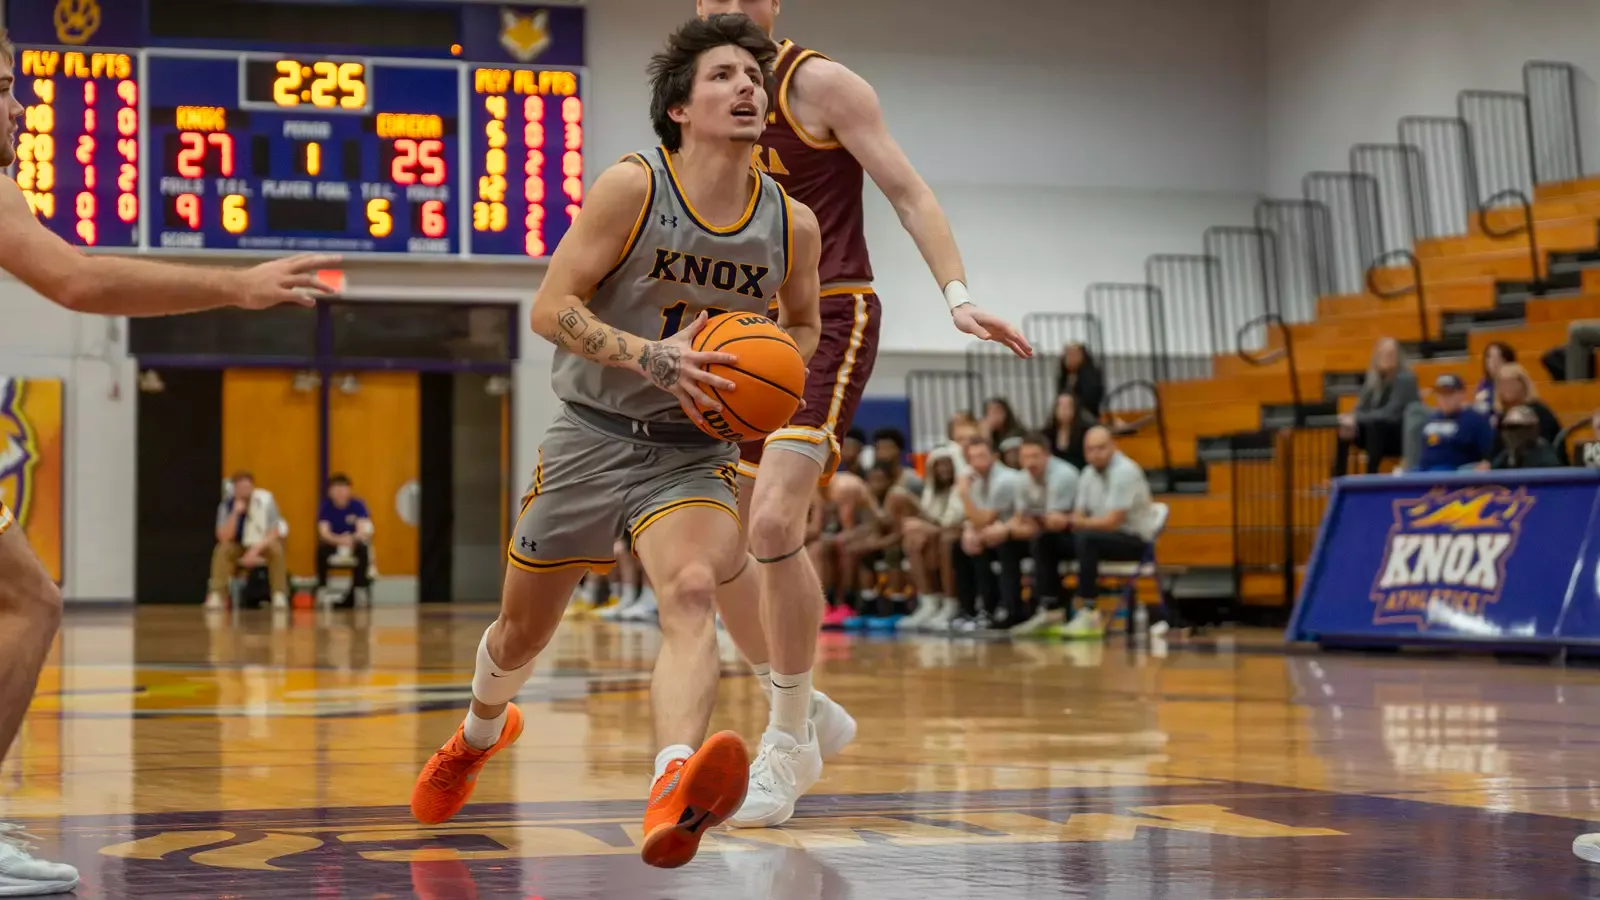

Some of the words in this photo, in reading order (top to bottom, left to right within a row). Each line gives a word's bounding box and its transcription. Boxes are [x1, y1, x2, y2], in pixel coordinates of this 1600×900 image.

[33, 78, 54, 104] 4
[84, 80, 96, 106] 1
[117, 79, 138, 107] 9
[273, 60, 366, 109] 2:25
[84, 107, 96, 133] 1
[117, 106, 138, 137] 0
[485, 95, 507, 121] 4
[17, 132, 54, 161] 20
[75, 134, 96, 165] 2
[117, 138, 138, 163] 4
[485, 119, 507, 148] 5
[564, 122, 583, 150] 3
[177, 131, 235, 179] 27
[306, 141, 321, 177] 1
[391, 138, 447, 187] 25
[525, 149, 545, 176] 2
[84, 164, 95, 190] 1
[117, 163, 138, 191] 2
[75, 191, 96, 220] 0
[117, 192, 138, 223] 0
[175, 193, 200, 231] 9
[222, 194, 248, 234] 6
[366, 198, 393, 238] 5
[421, 200, 447, 238] 6
[473, 201, 508, 233] 33
[525, 203, 546, 230] 2
[75, 219, 96, 247] 9
[525, 229, 546, 258] 6
[648, 248, 769, 299] KNOX
[1379, 534, 1511, 590] KNOX
